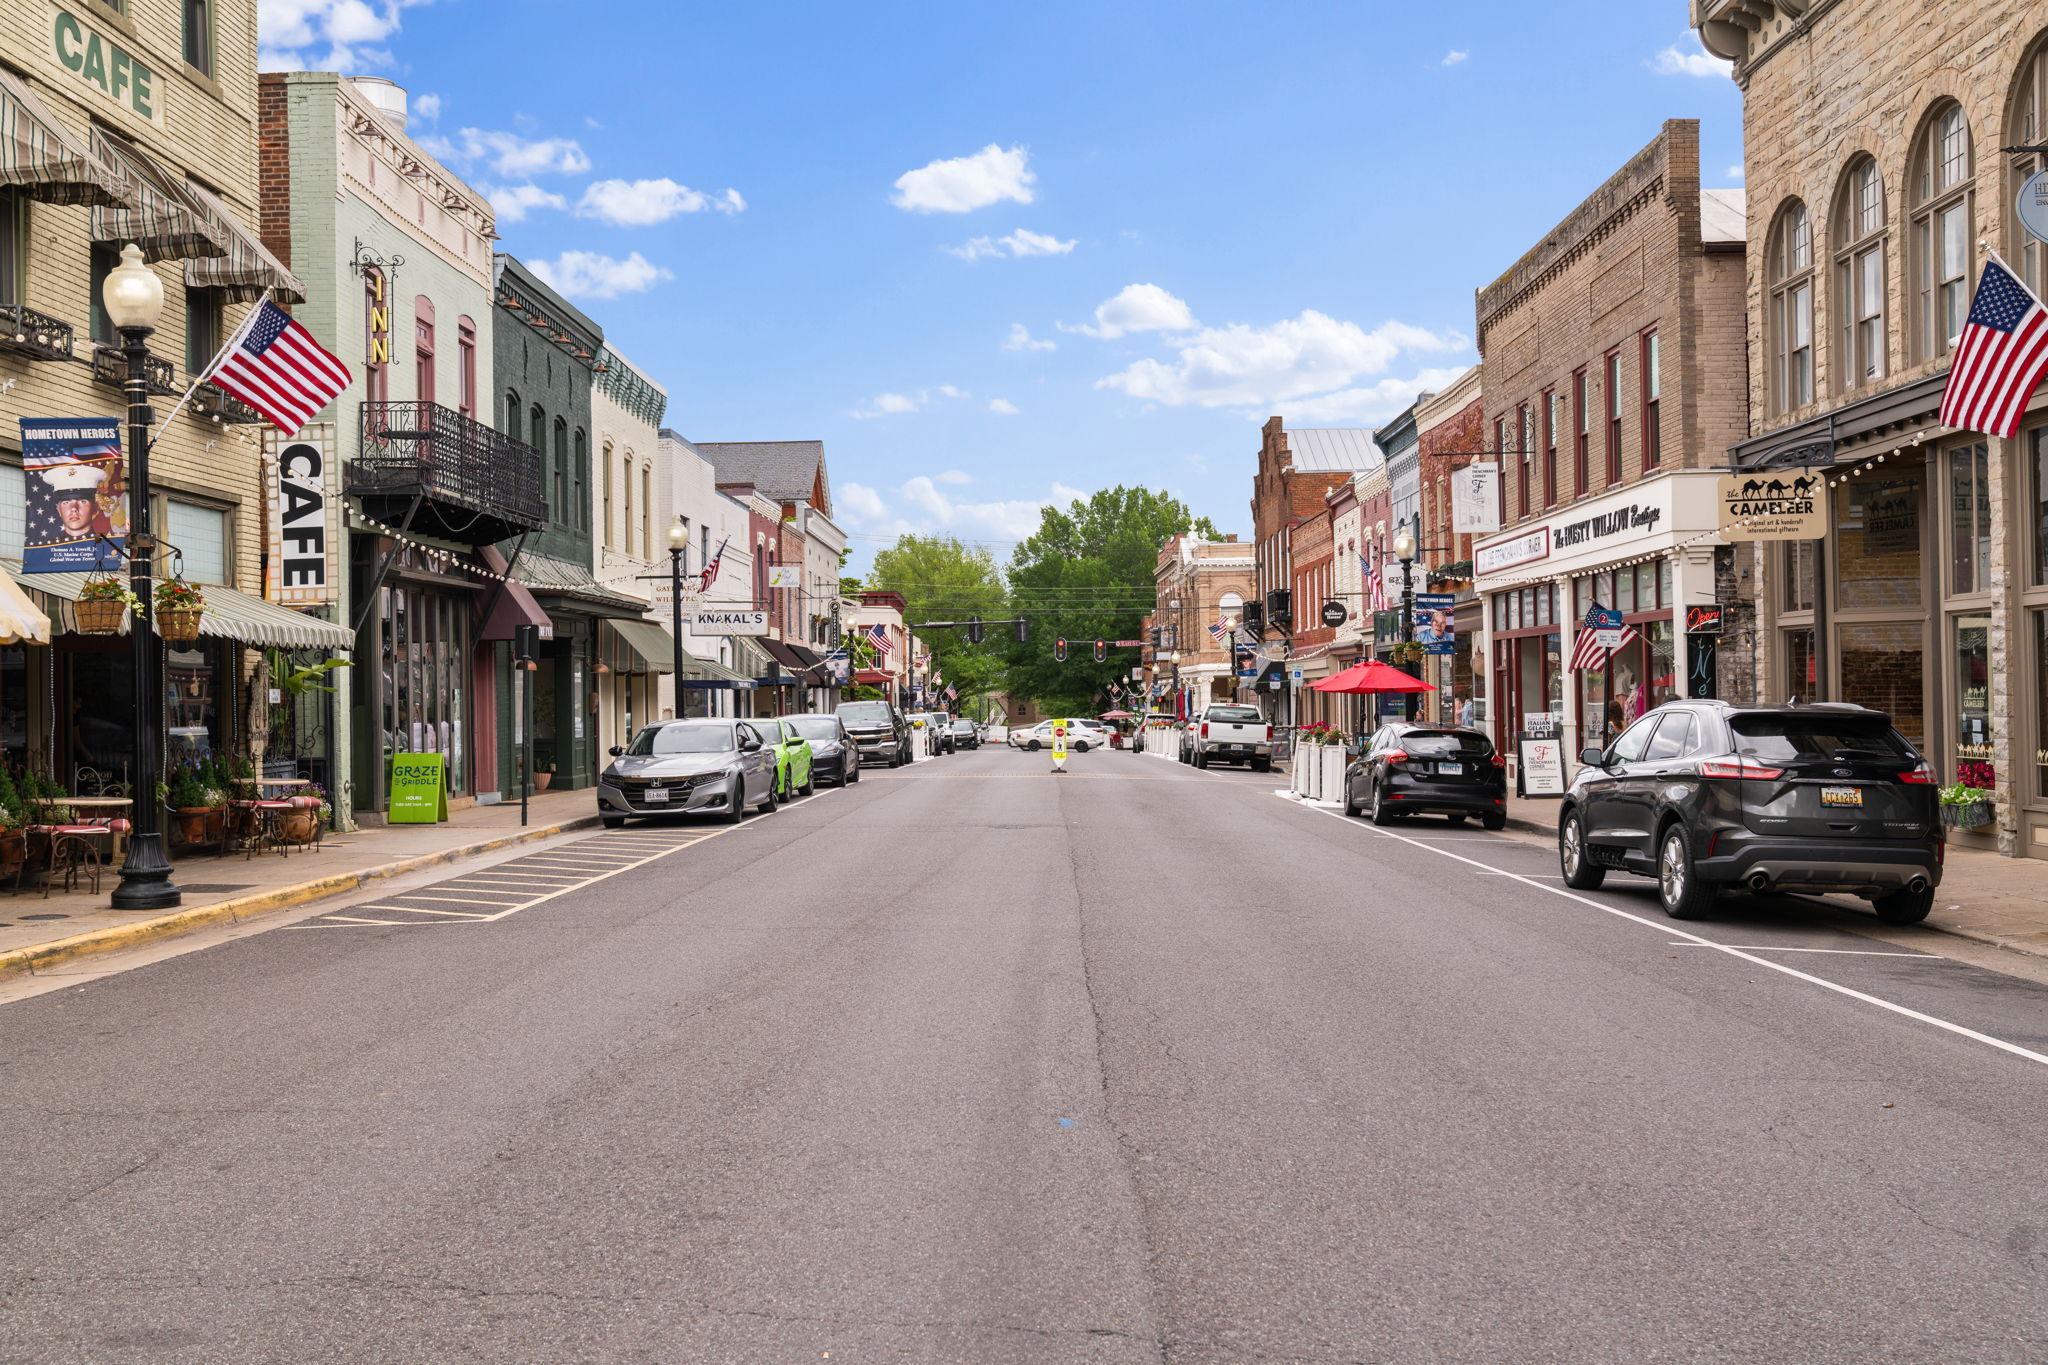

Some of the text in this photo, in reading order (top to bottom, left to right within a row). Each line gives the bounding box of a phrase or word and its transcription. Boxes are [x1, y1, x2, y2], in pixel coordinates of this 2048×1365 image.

[54, 12, 153, 119] CAFE
[371, 276, 389, 363] INN
[25, 428, 116, 440] HOMETOWN HEROES
[1727, 489, 1739, 498] the
[279, 443, 326, 587] CAFE
[1730, 501, 1814, 516] CAMELEER
[1564, 519, 1591, 547] RUSTY
[1591, 507, 1630, 539] WILLOW
[698, 613, 763, 624] KNAKAL'S
[1687, 608, 1720, 631] Open
[394, 766, 438, 778] GRAZE
[401, 778, 438, 787] GRIDDLE
[1844, 793, 1859, 803] 265
